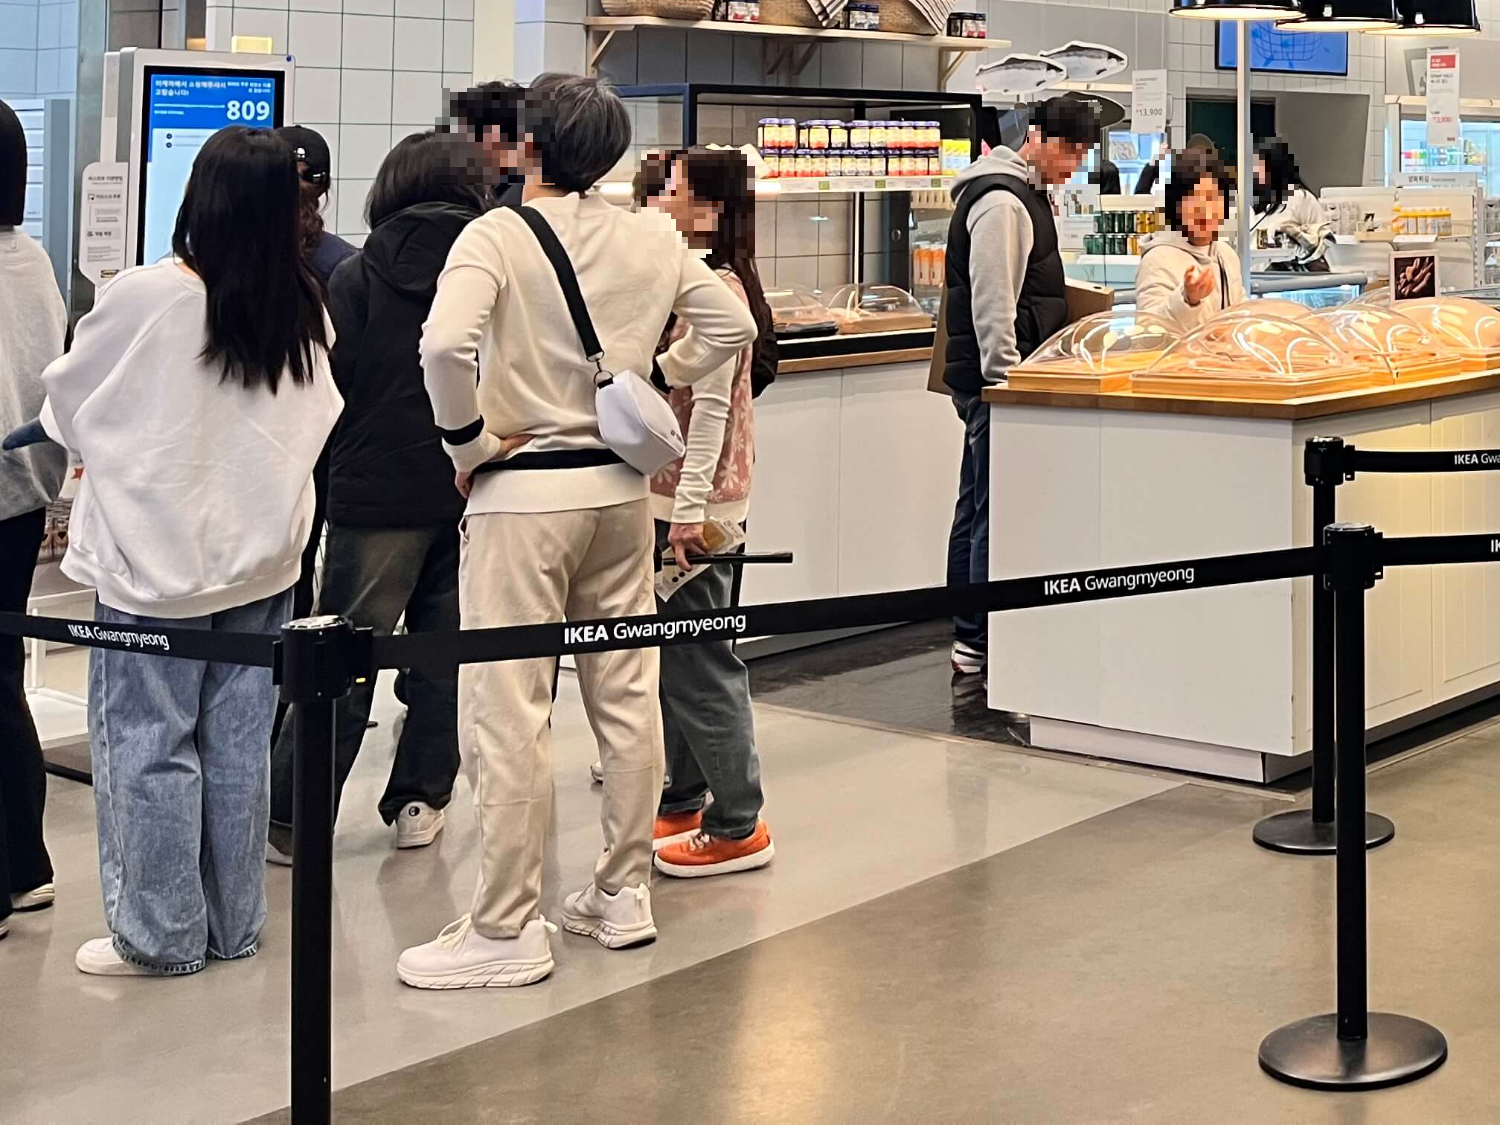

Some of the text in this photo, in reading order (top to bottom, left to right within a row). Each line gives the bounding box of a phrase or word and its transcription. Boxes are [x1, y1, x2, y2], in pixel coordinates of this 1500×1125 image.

[226, 100, 270, 121] 809
[1454, 454, 1479, 465] IKEA
[1044, 568, 1195, 595] IKEA Gwangmyeong
[68, 624, 169, 650] IKEA Gwangmyeong
[564, 615, 746, 644] IKEA Gwangmyeong
